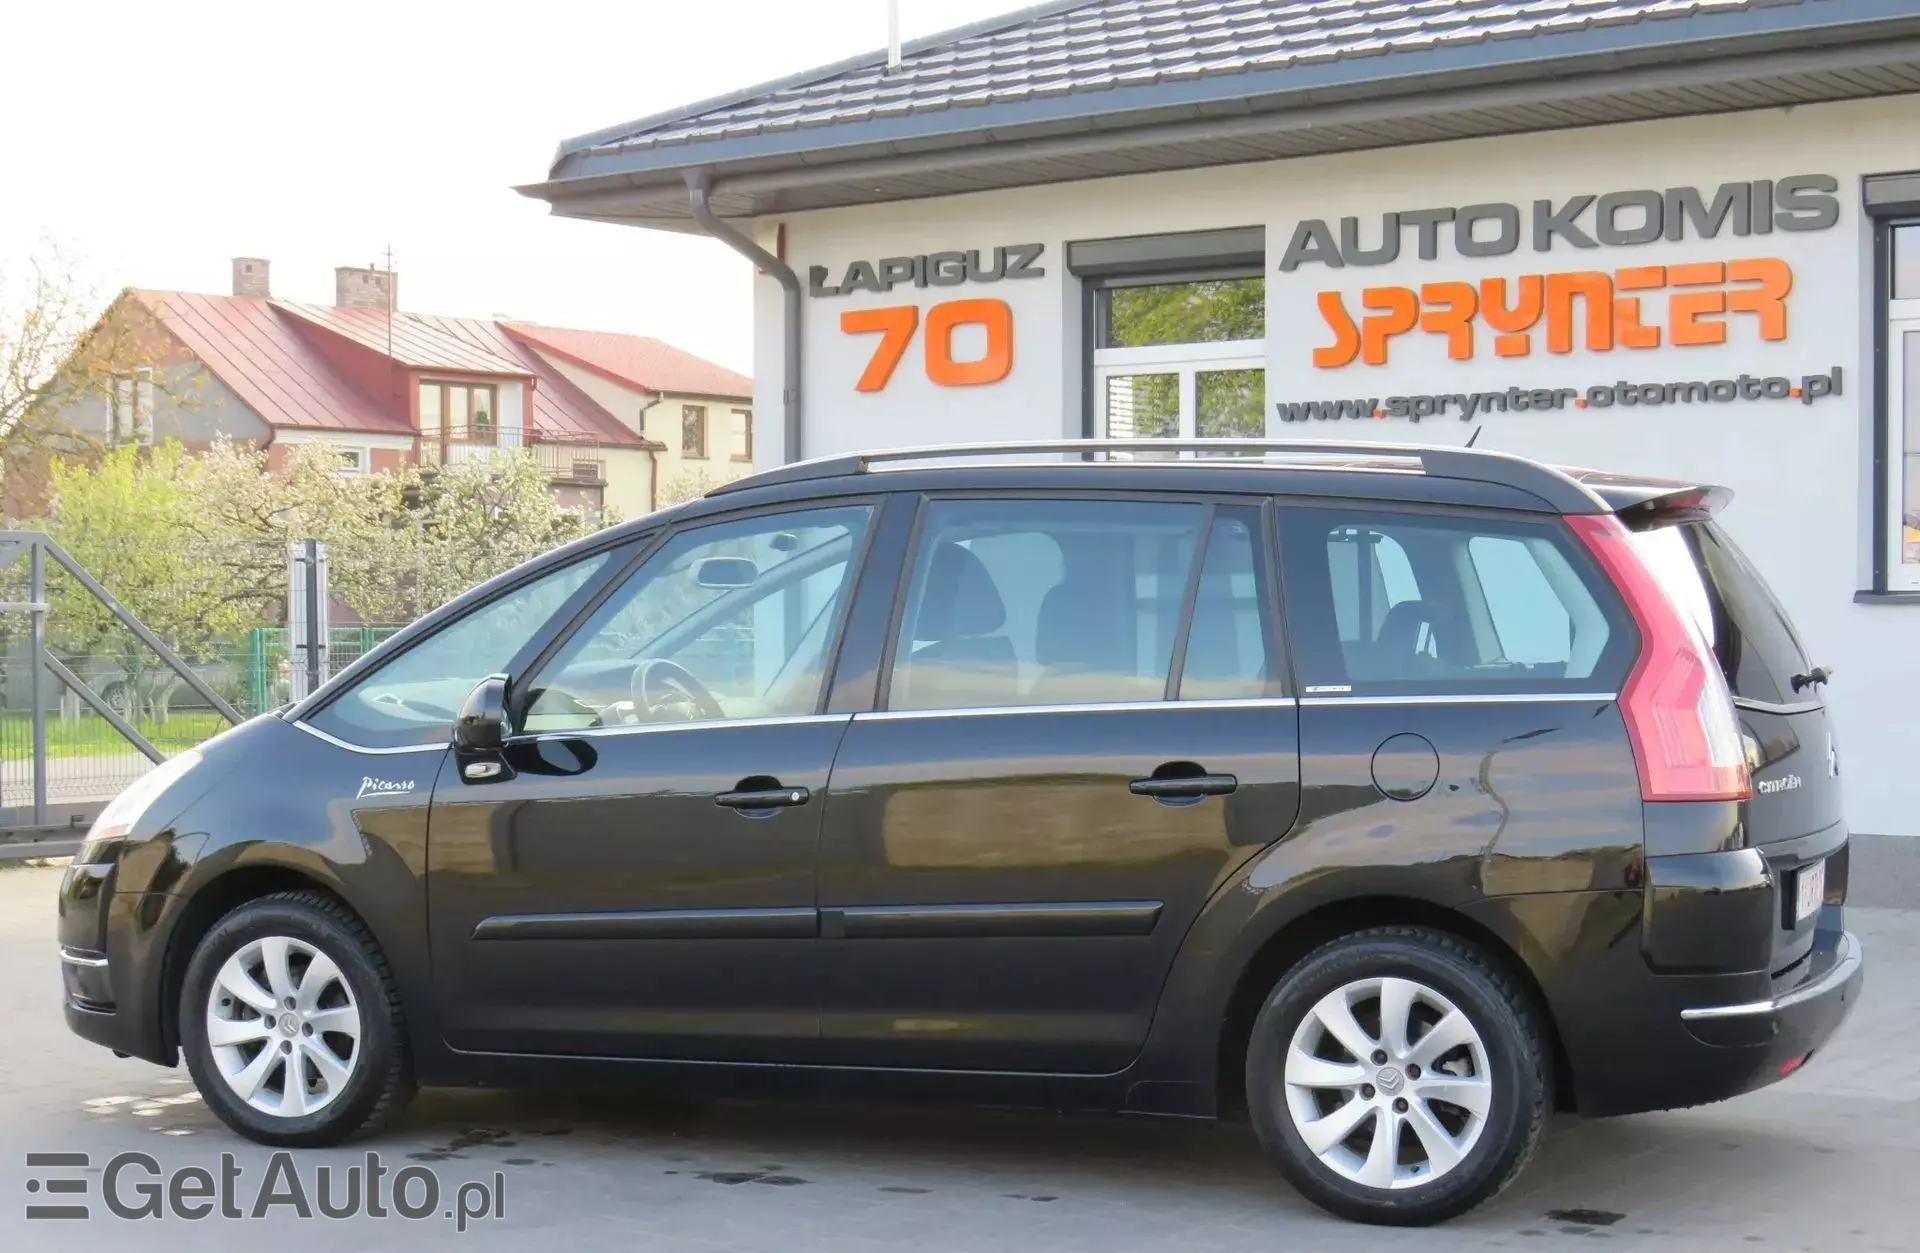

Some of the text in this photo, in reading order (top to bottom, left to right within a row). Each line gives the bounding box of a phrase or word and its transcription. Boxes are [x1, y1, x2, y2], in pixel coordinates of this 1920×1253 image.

[1277, 174, 1841, 273] AUTO KOMIS
[809, 242, 1046, 298] ŁAPIGUZ
[840, 297, 1013, 393] 70
[1312, 257, 1794, 368] SPRYNTER
[1276, 366, 1843, 423] www.sprynter.otomoto.pl
[356, 776, 416, 800] Picasso
